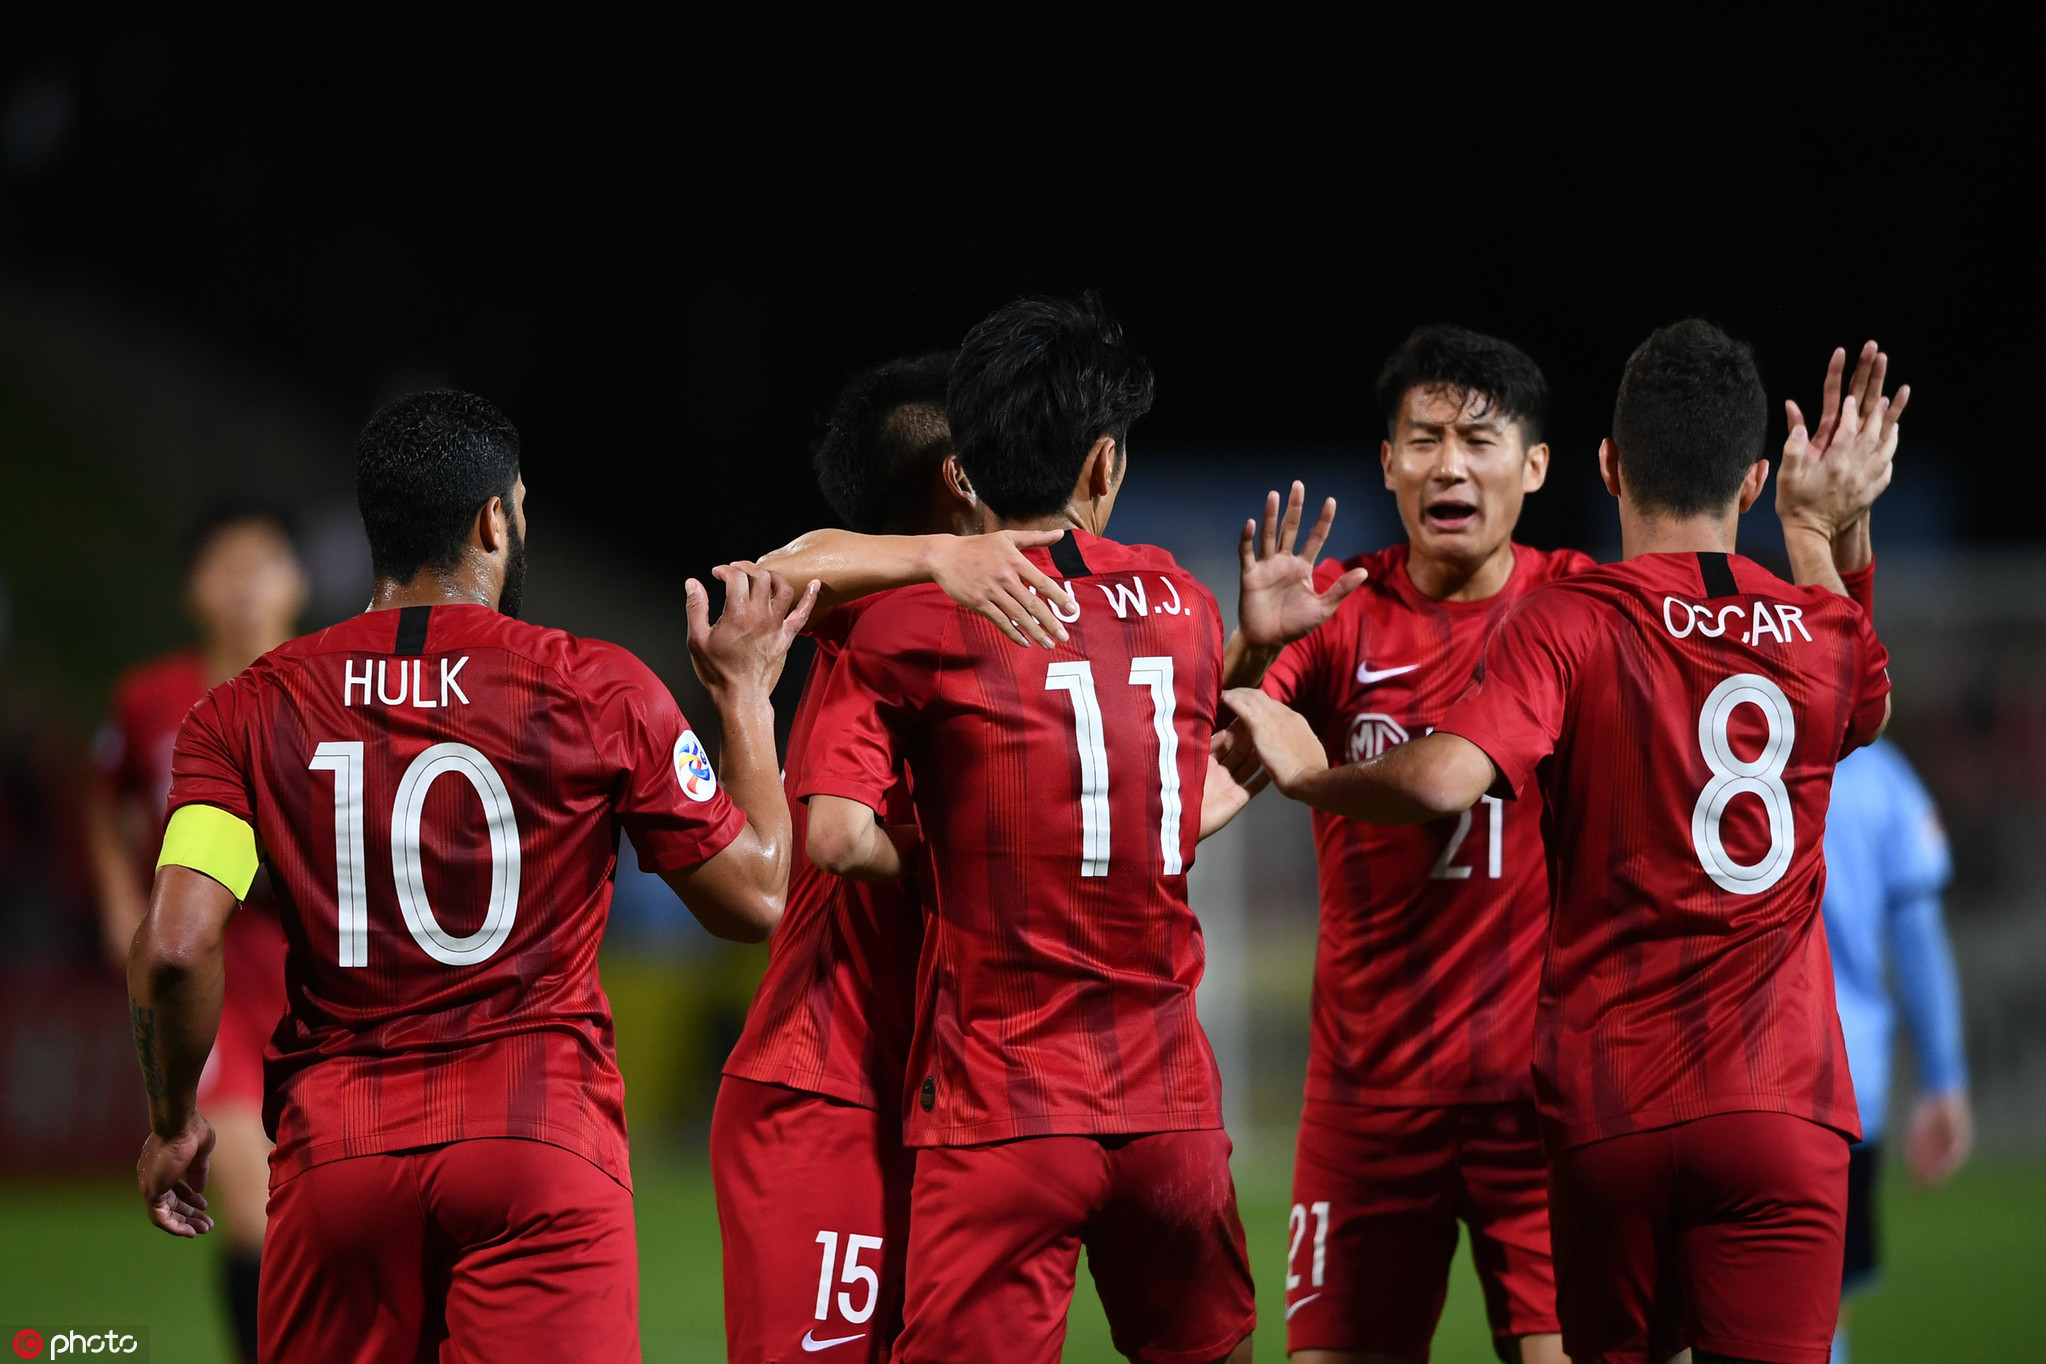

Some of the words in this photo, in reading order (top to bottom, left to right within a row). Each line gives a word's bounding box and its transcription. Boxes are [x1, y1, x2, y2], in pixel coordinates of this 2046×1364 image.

[1097, 576, 1191, 619] W.J.
[1663, 596, 1812, 647] OSCAR
[344, 656, 470, 707] HULK
[1045, 656, 1182, 877] 11
[1692, 673, 1795, 895] 8
[309, 741, 521, 968] 10
[1429, 793, 1503, 880] 21
[815, 1230, 884, 1324] 15
[1285, 1201, 1330, 1290] 21
